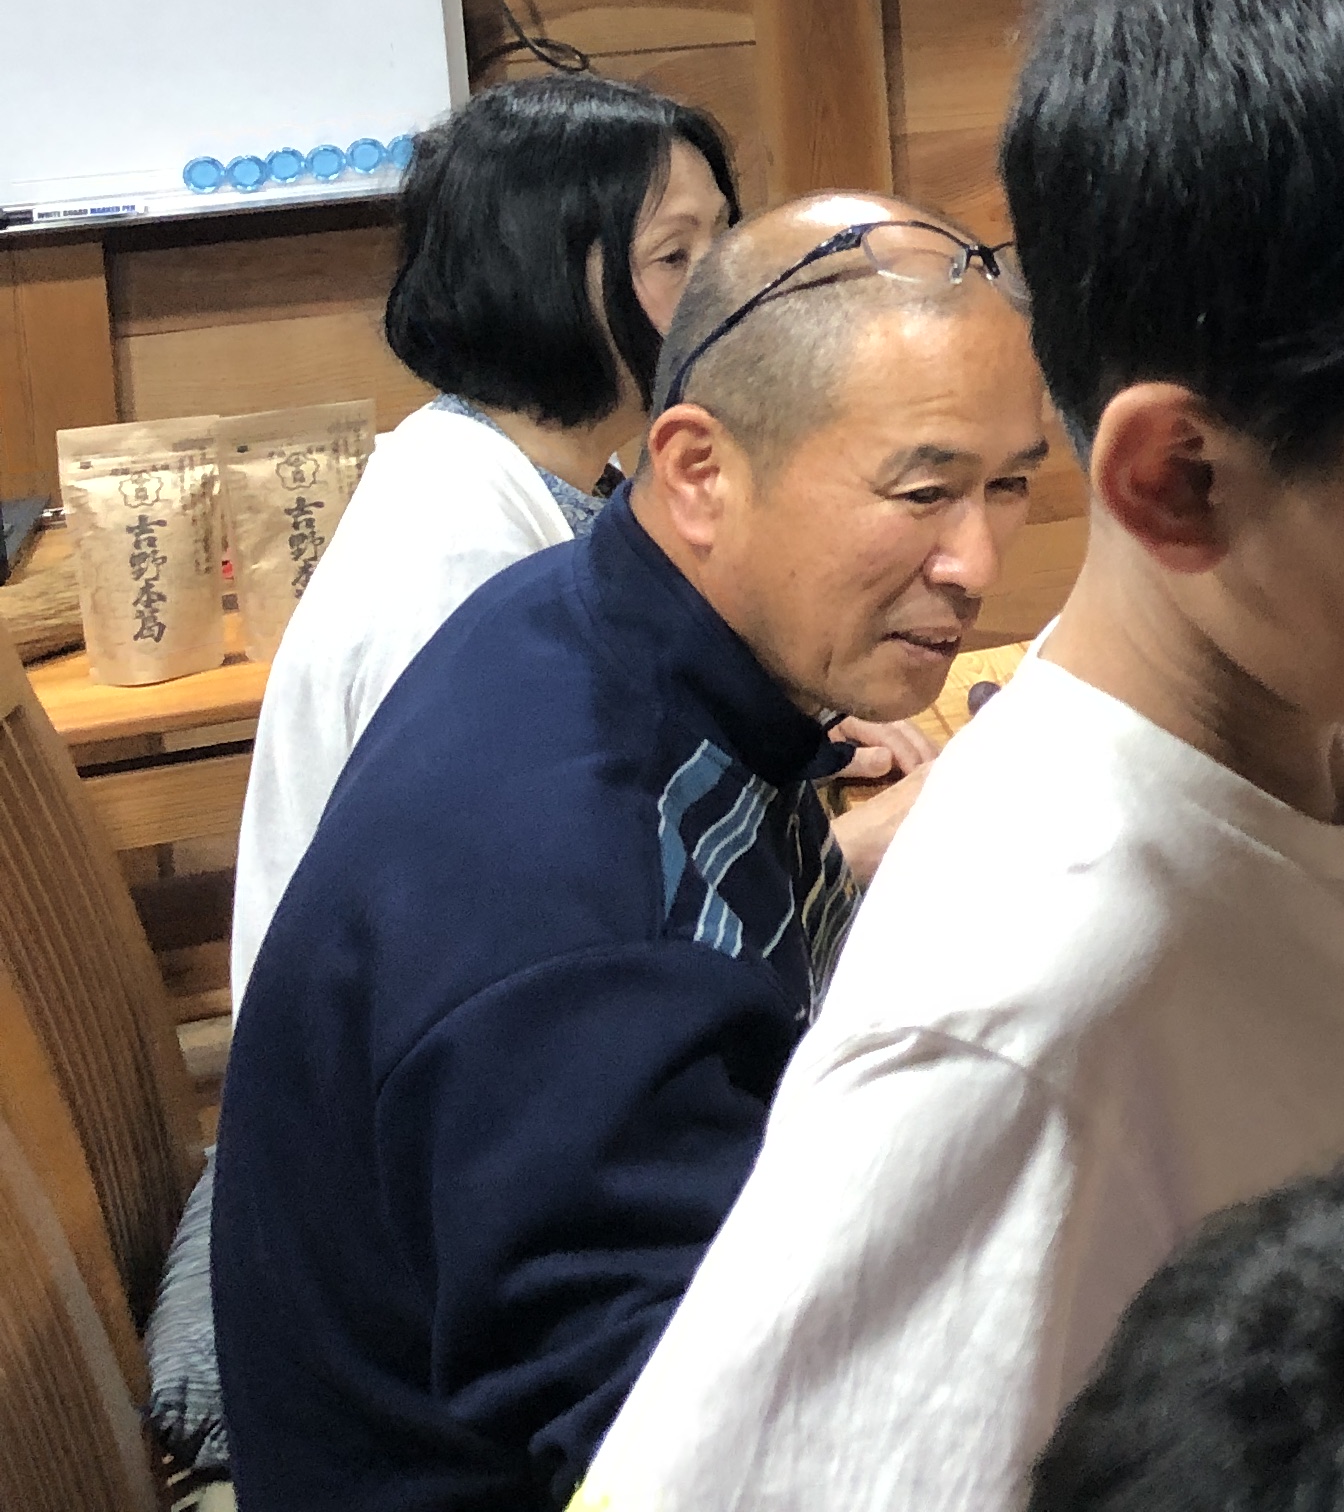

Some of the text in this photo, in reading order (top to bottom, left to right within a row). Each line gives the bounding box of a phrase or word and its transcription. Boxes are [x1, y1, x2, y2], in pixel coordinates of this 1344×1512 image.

[126, 514, 168, 643] 吉野本葛
[284, 496, 325, 599] 吉野本
